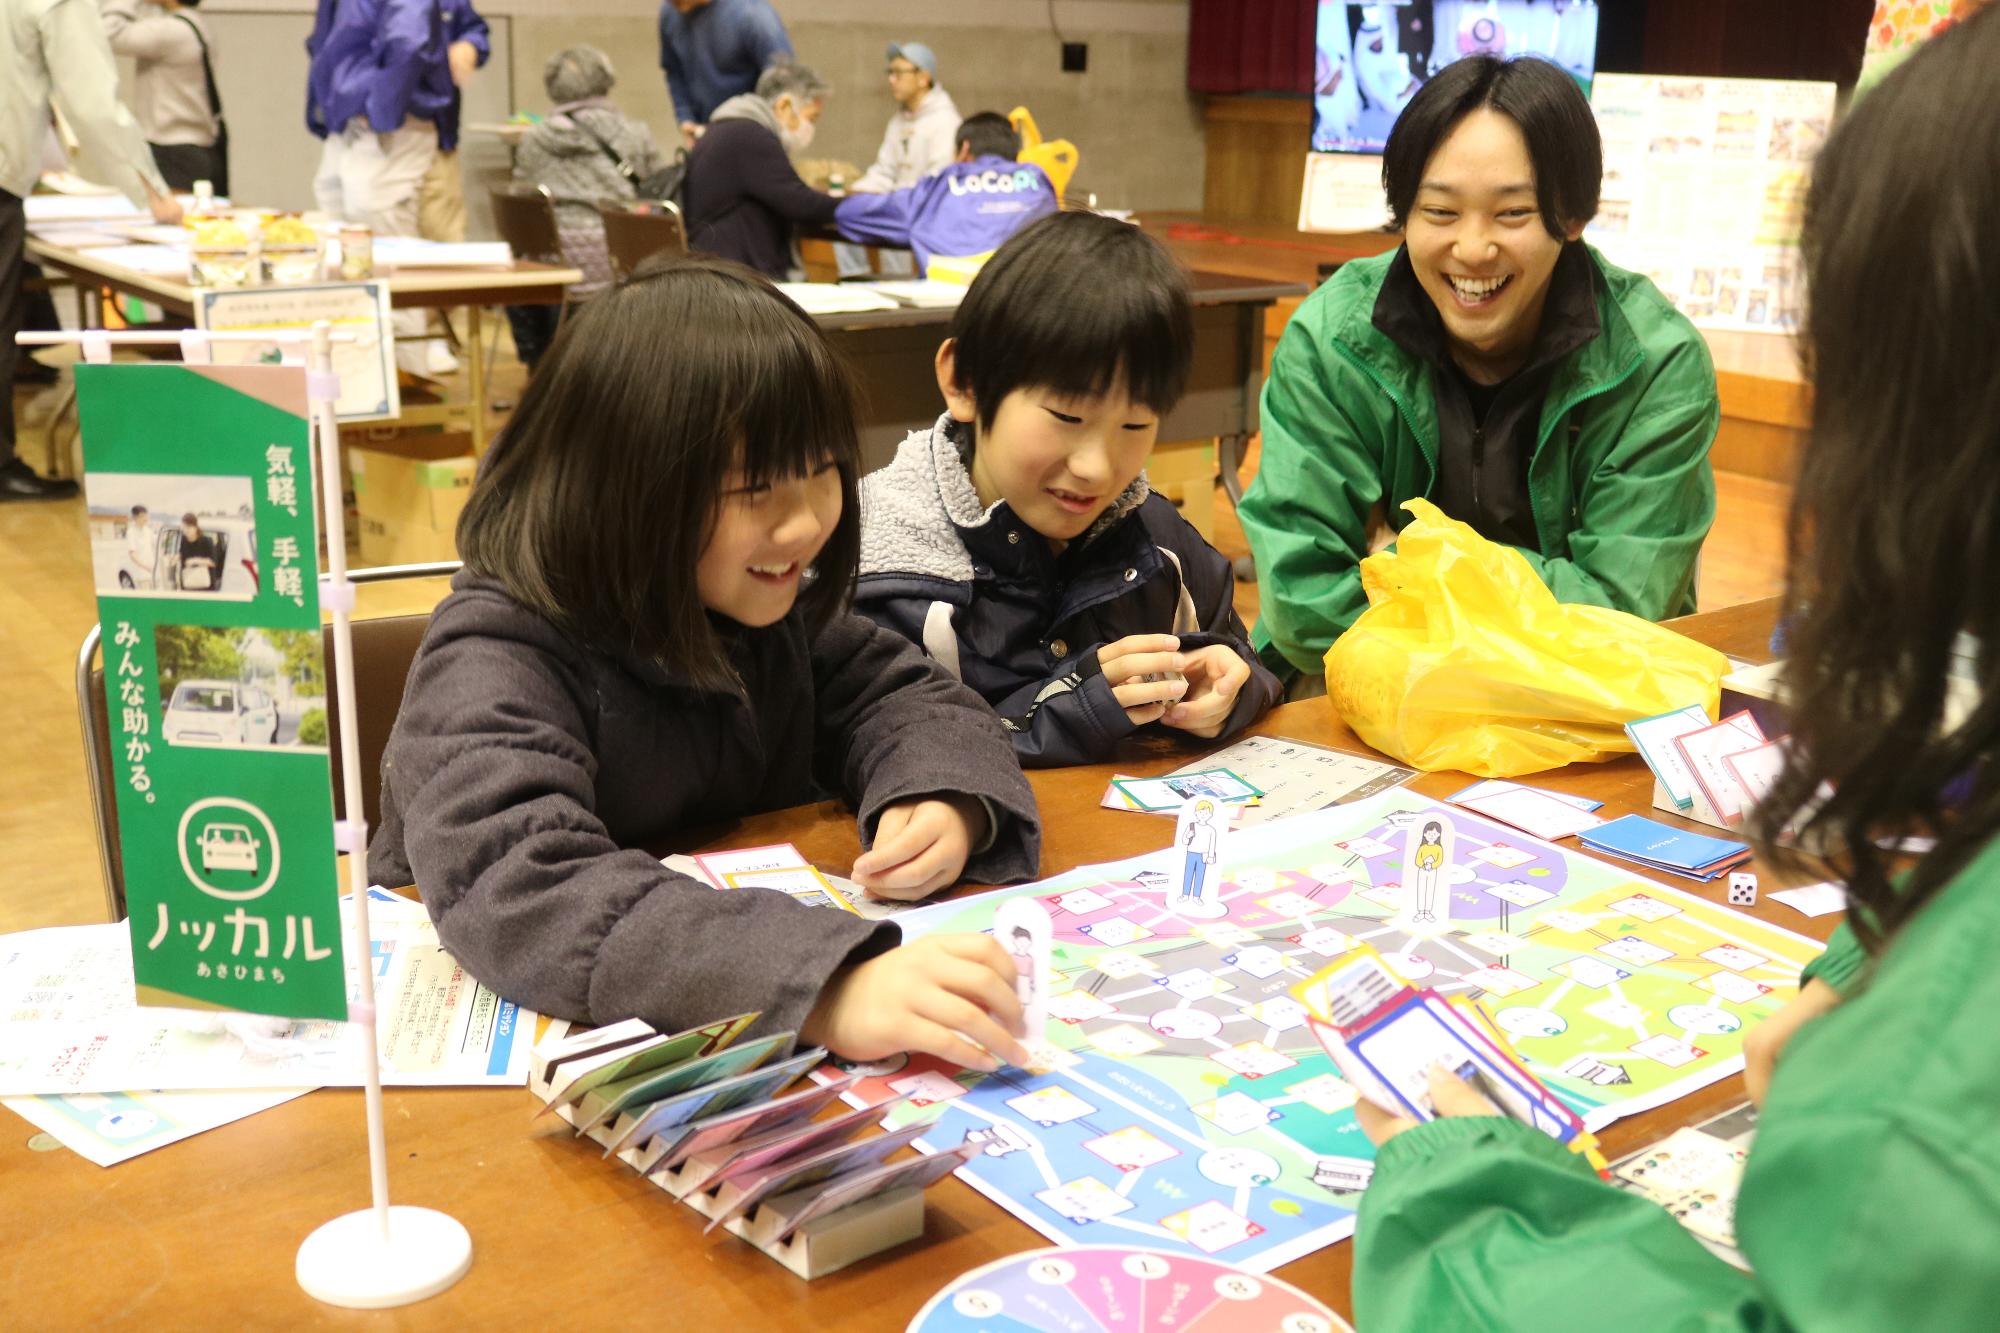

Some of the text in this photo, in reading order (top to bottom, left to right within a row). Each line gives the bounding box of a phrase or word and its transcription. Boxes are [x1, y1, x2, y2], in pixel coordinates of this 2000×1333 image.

[114, 620, 155, 804] みんな助かる。
[147, 903, 332, 962] ノッカル
[196, 962, 286, 985] あさひまち
